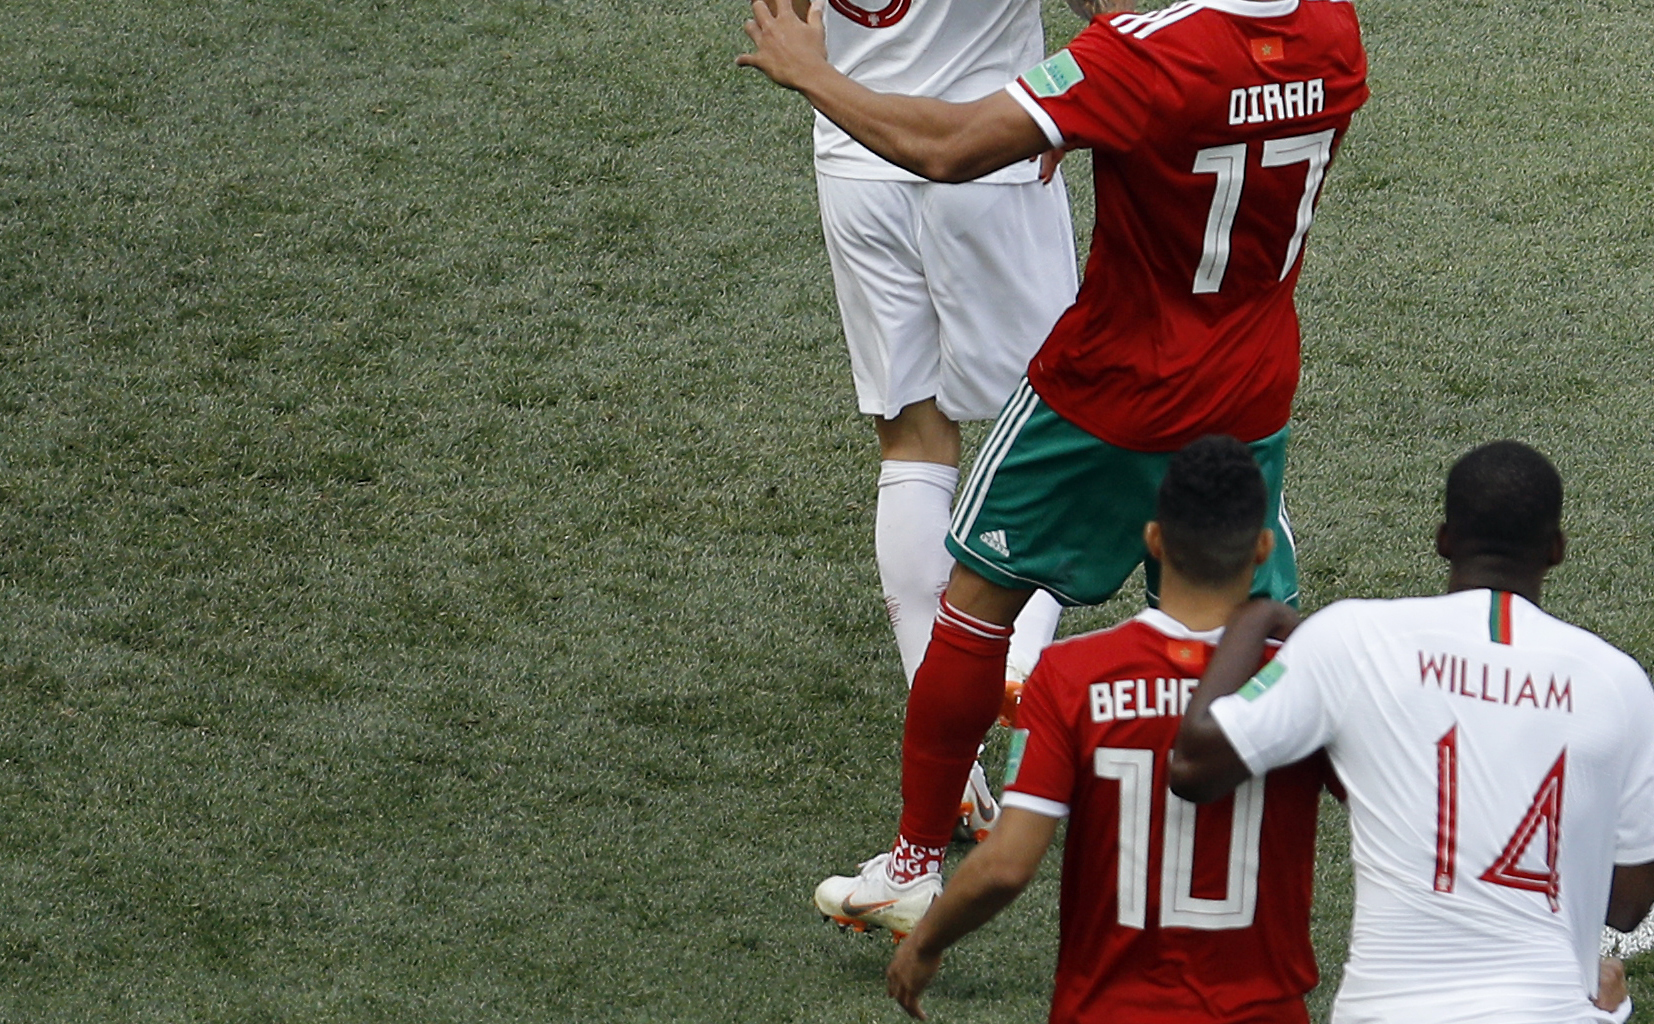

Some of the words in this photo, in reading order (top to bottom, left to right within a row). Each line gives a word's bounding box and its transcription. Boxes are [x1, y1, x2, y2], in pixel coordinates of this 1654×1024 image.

[1228, 77, 1325, 126] DIRAR
[1191, 127, 1337, 294] 17
[1417, 649, 1574, 714] WILLIAM
[1093, 746, 1267, 931] 10
[1433, 720, 1568, 914] 14
